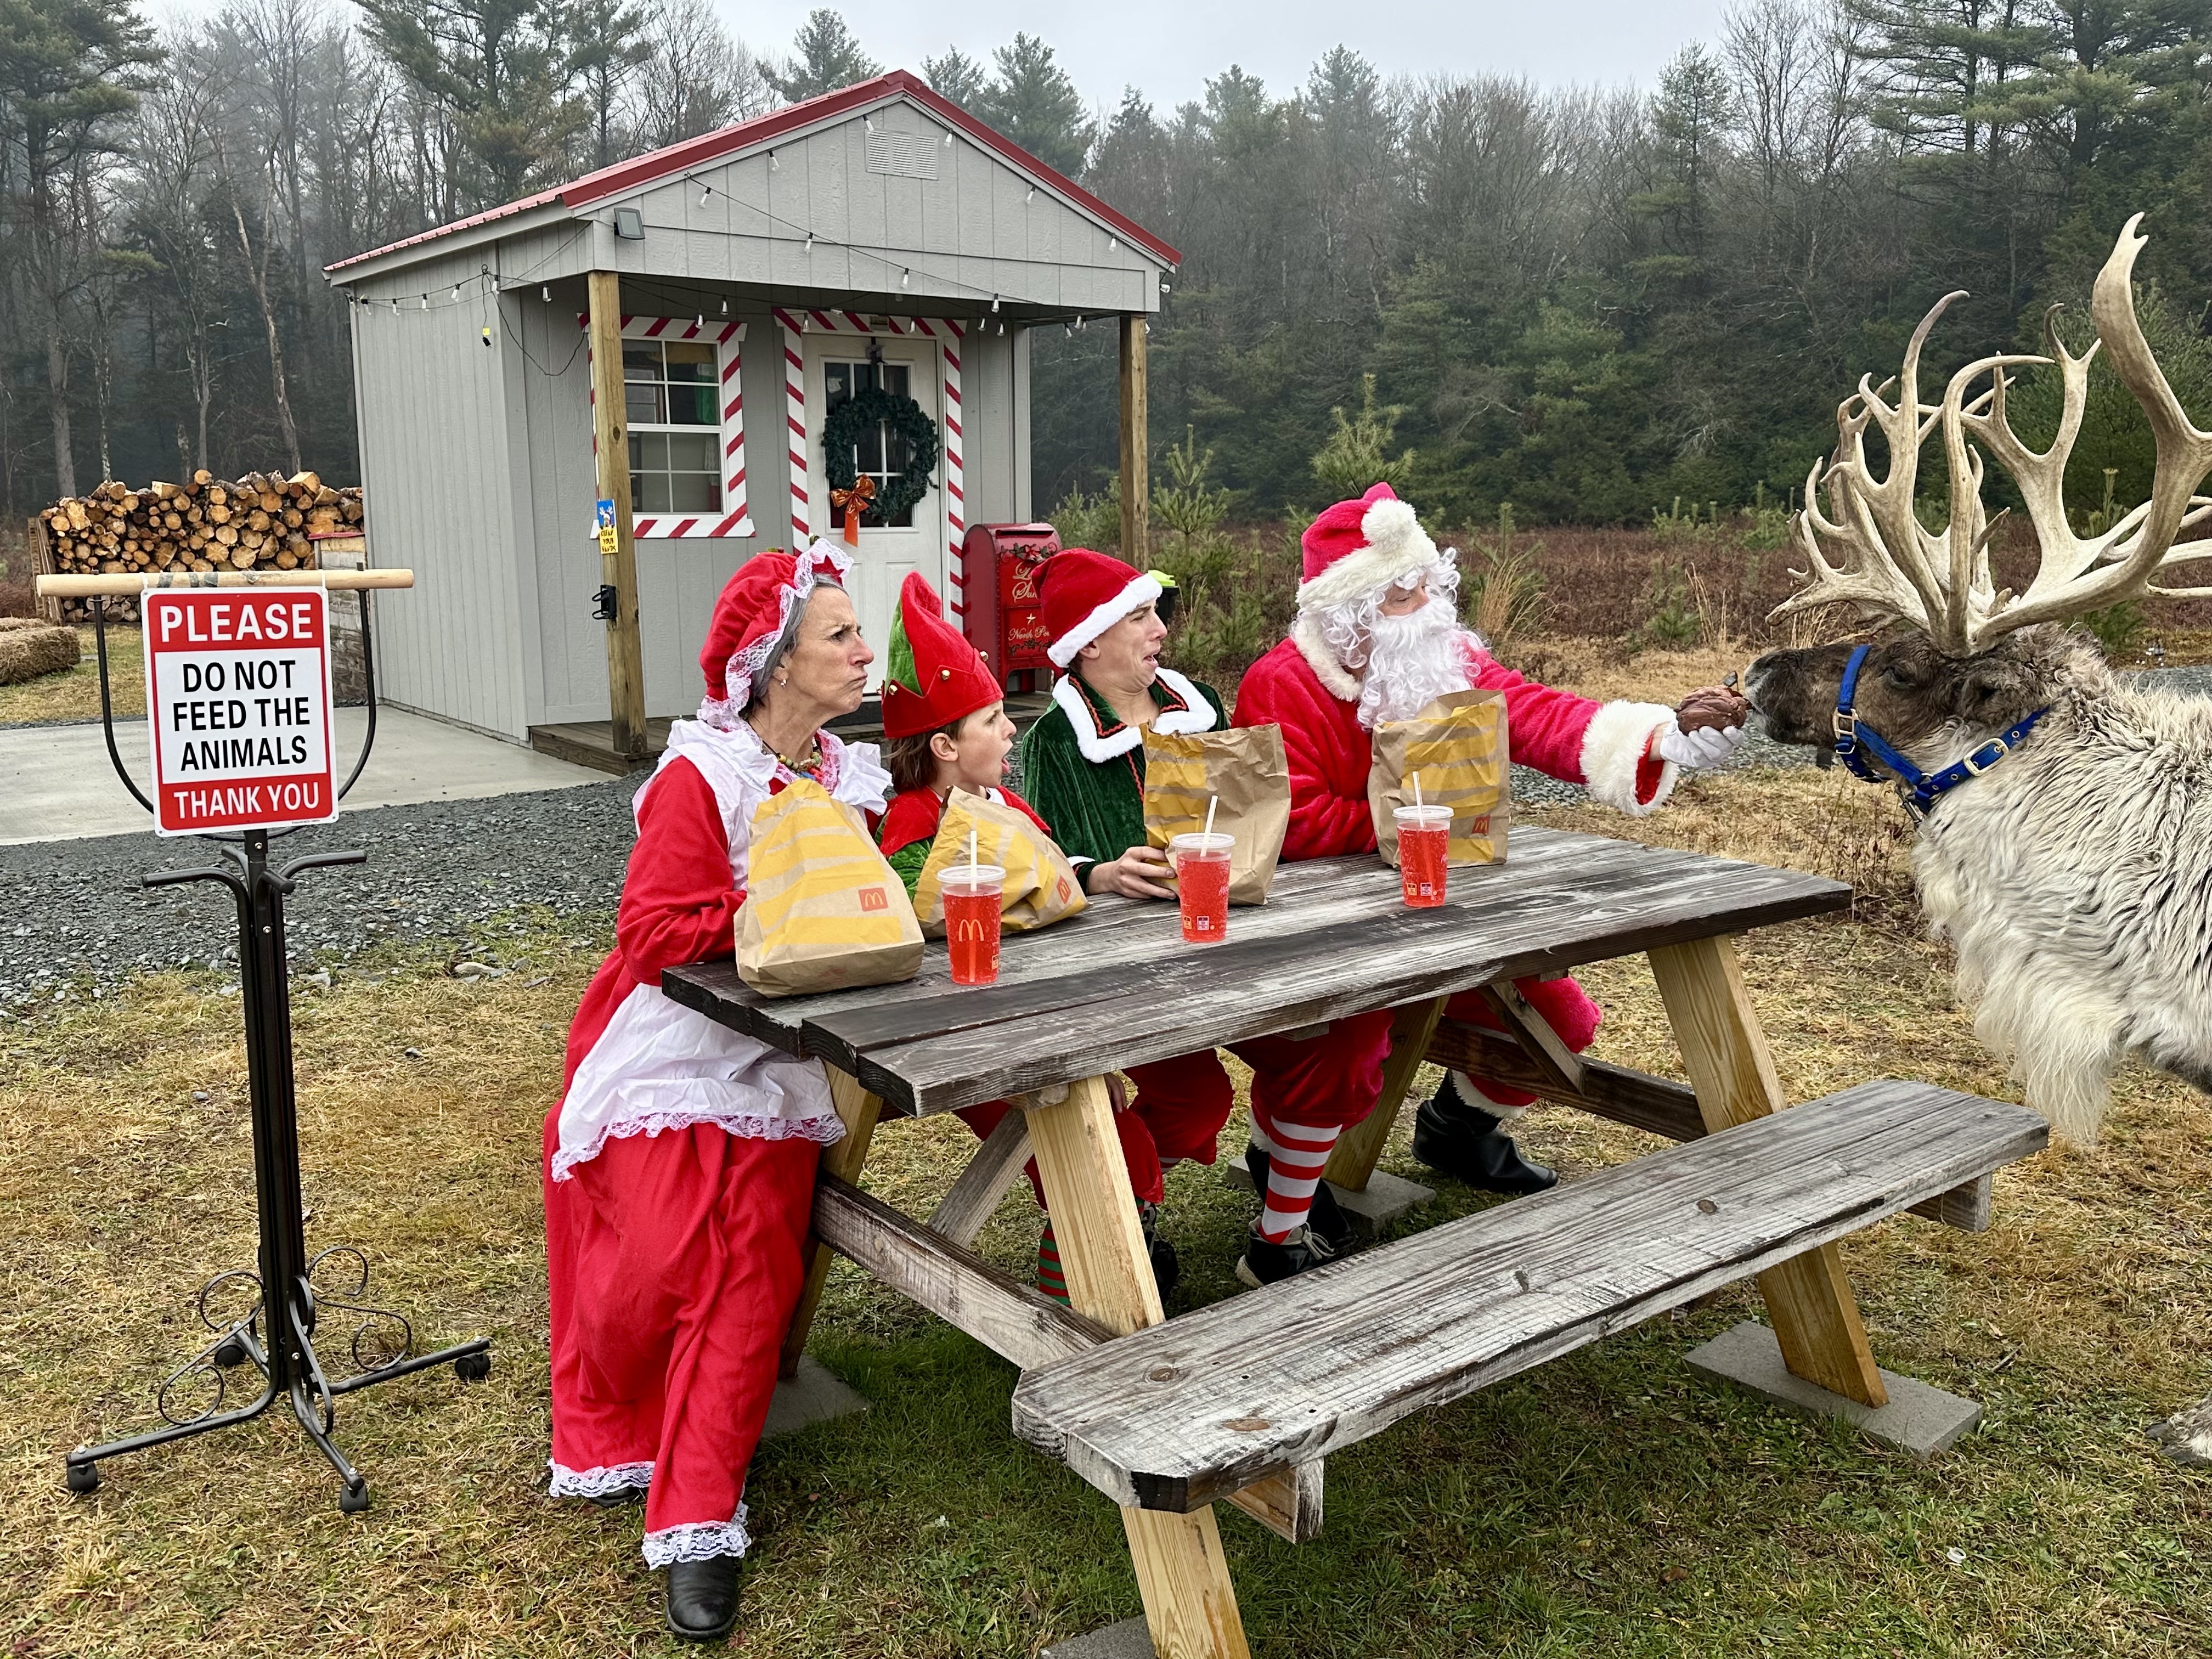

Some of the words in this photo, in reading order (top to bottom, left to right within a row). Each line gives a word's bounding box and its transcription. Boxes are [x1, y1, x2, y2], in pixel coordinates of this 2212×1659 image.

[160, 603, 313, 642] PLEASE
[1008, 628, 1033, 641] North
[183, 662, 225, 693] DO
[234, 660, 296, 691] NOT
[173, 700, 246, 732] FEED
[254, 696, 310, 727] THE
[180, 735, 307, 771] ANIMALS
[173, 786, 262, 819] THANK
[267, 782, 319, 811] YOU
[958, 919, 985, 942] M
